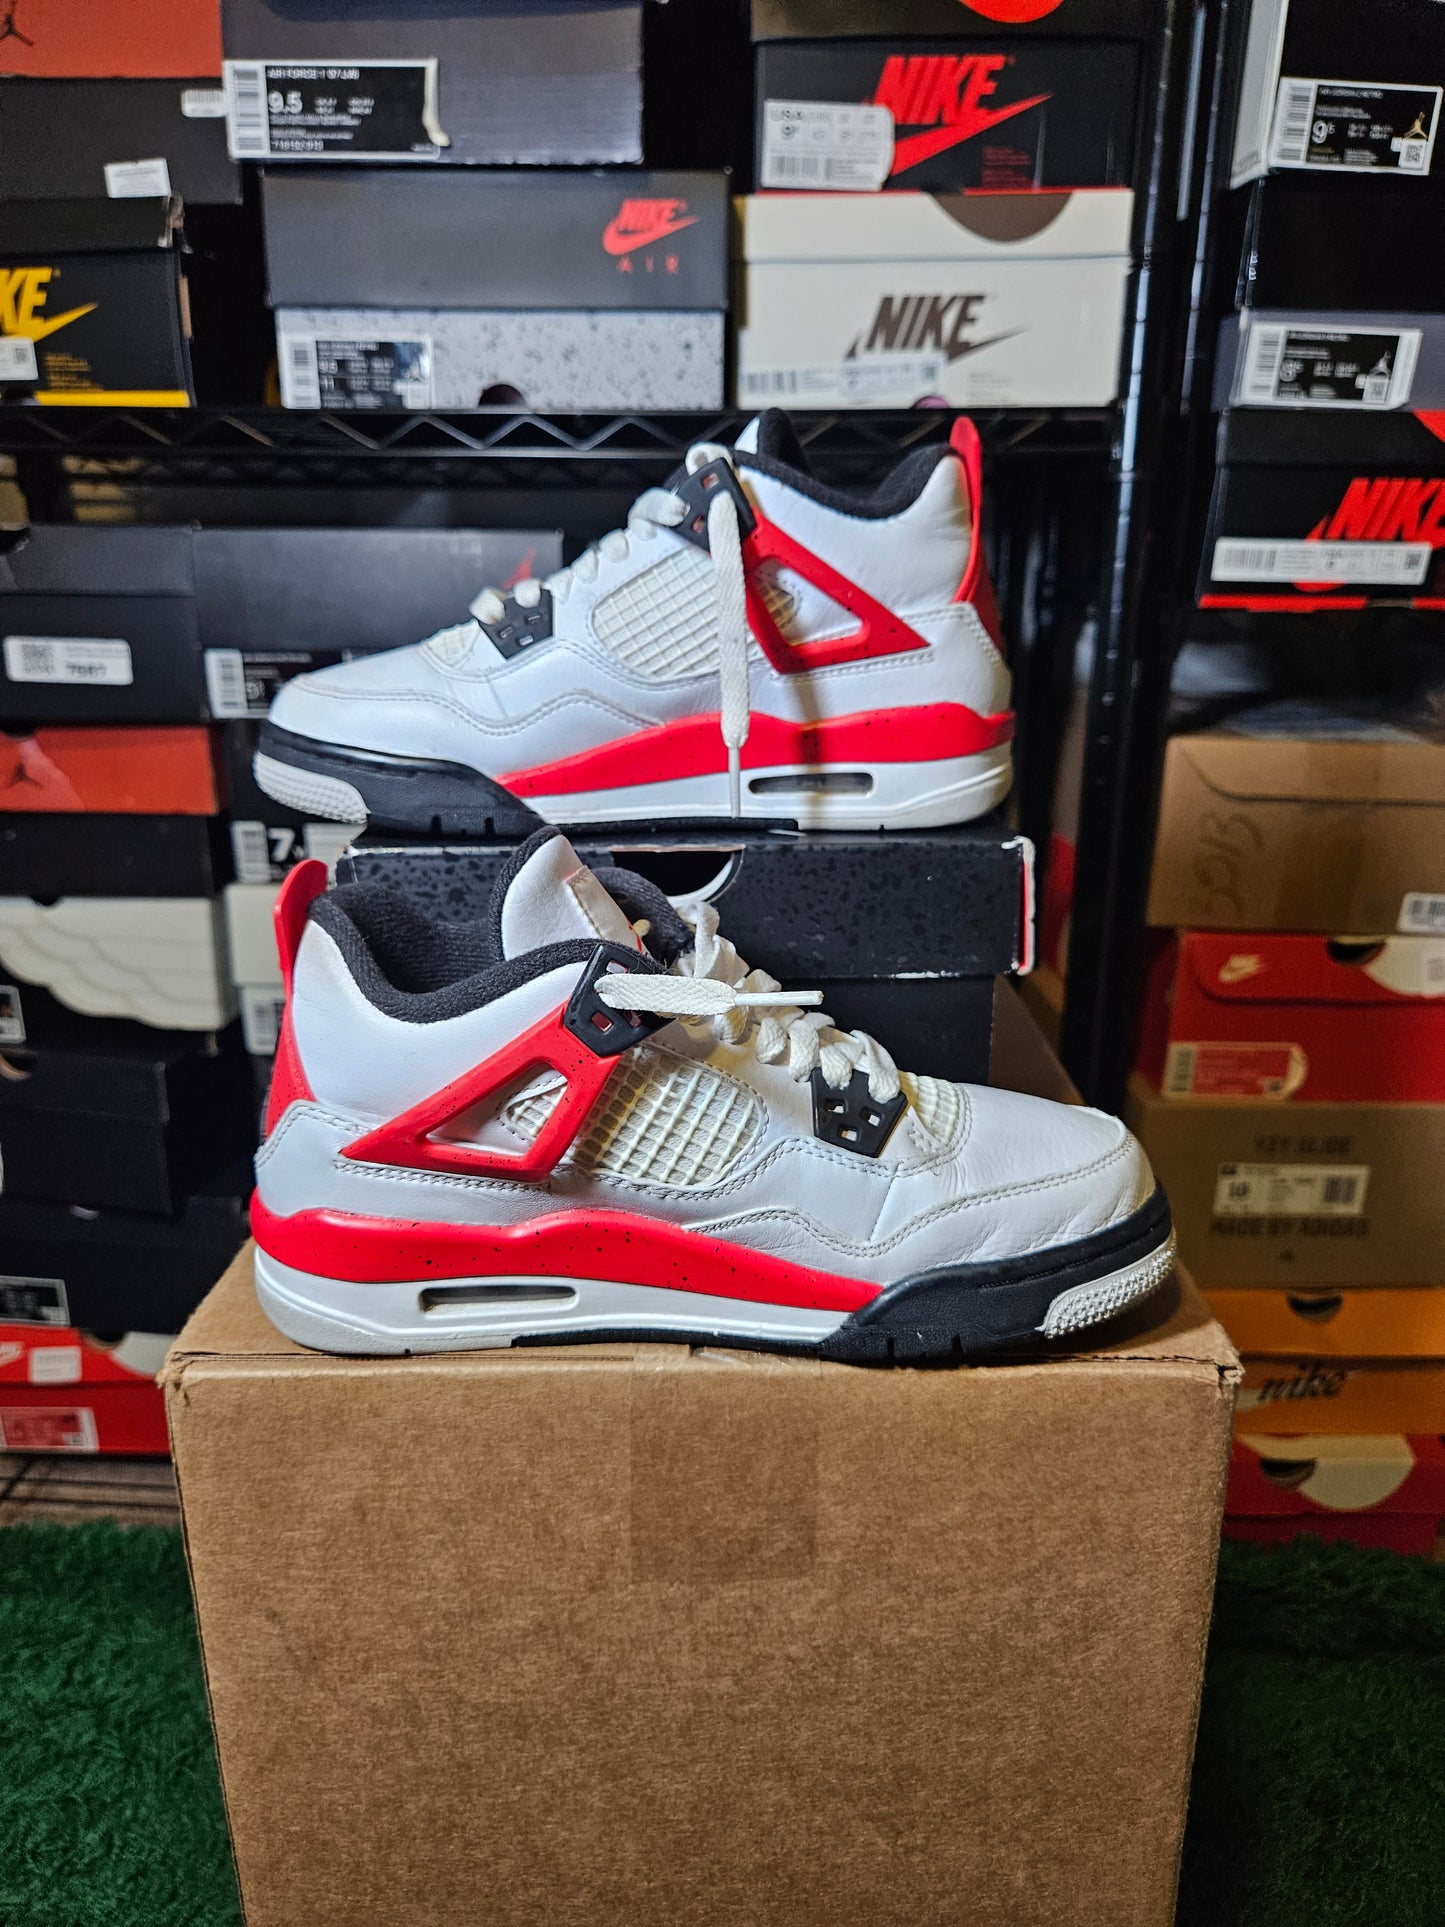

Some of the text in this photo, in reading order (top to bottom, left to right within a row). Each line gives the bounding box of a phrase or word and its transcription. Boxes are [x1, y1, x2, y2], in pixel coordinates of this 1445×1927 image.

[267, 90, 303, 114] 9.5
[873, 55, 1005, 126] NIKE
[616, 254, 680, 275] AIR
[863, 295, 985, 352] NIKE
[1257, 1361, 1346, 1401] nike
